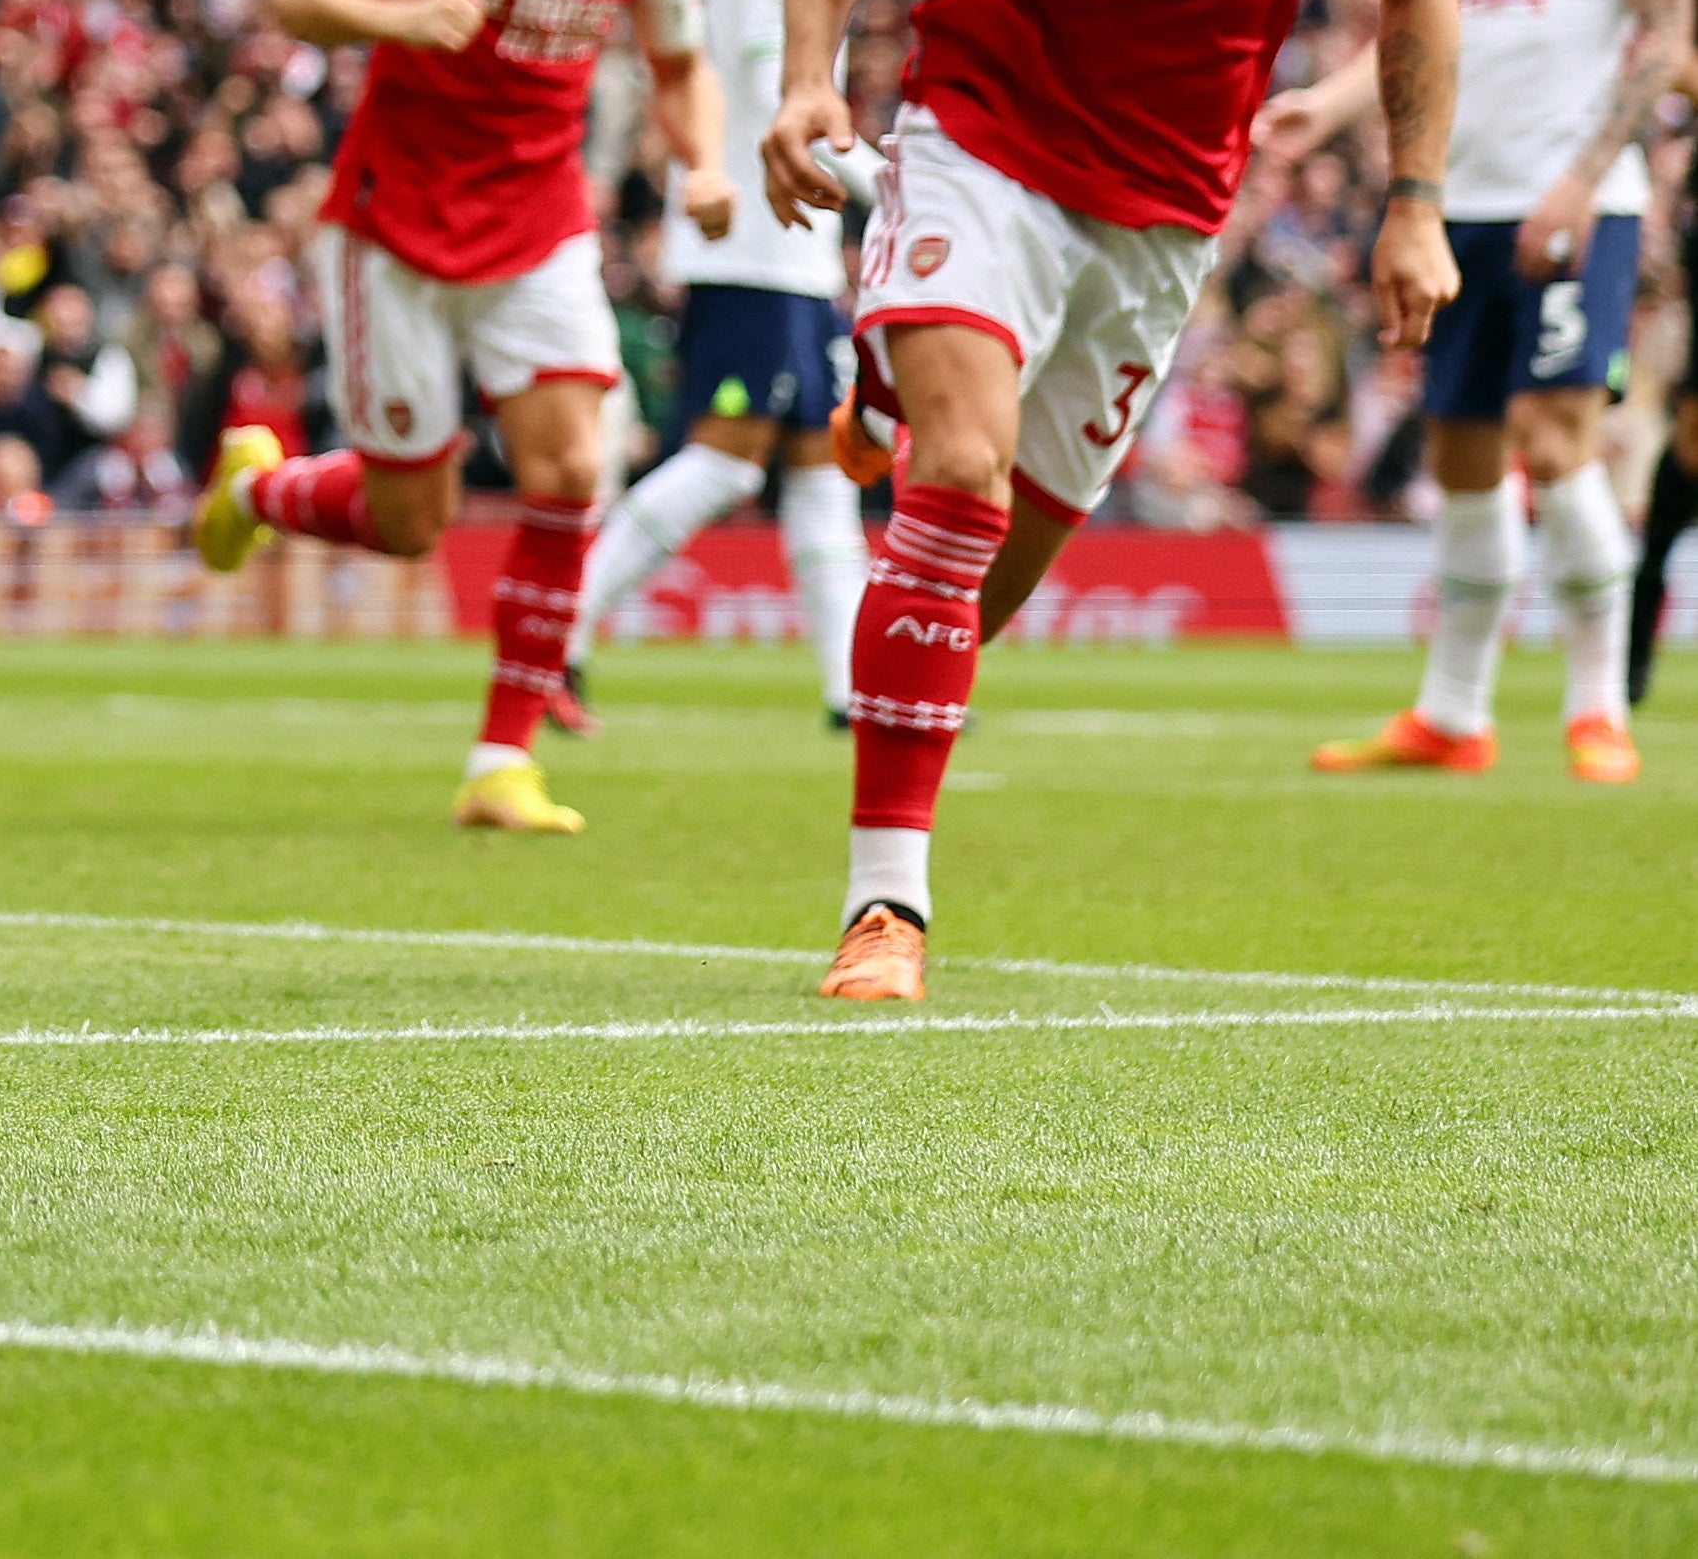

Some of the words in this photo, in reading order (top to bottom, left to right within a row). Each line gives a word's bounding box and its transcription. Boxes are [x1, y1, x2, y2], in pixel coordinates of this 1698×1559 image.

[1536, 280, 1587, 354] 5
[1081, 361, 1151, 446] 3
[884, 612, 974, 651] AFC
